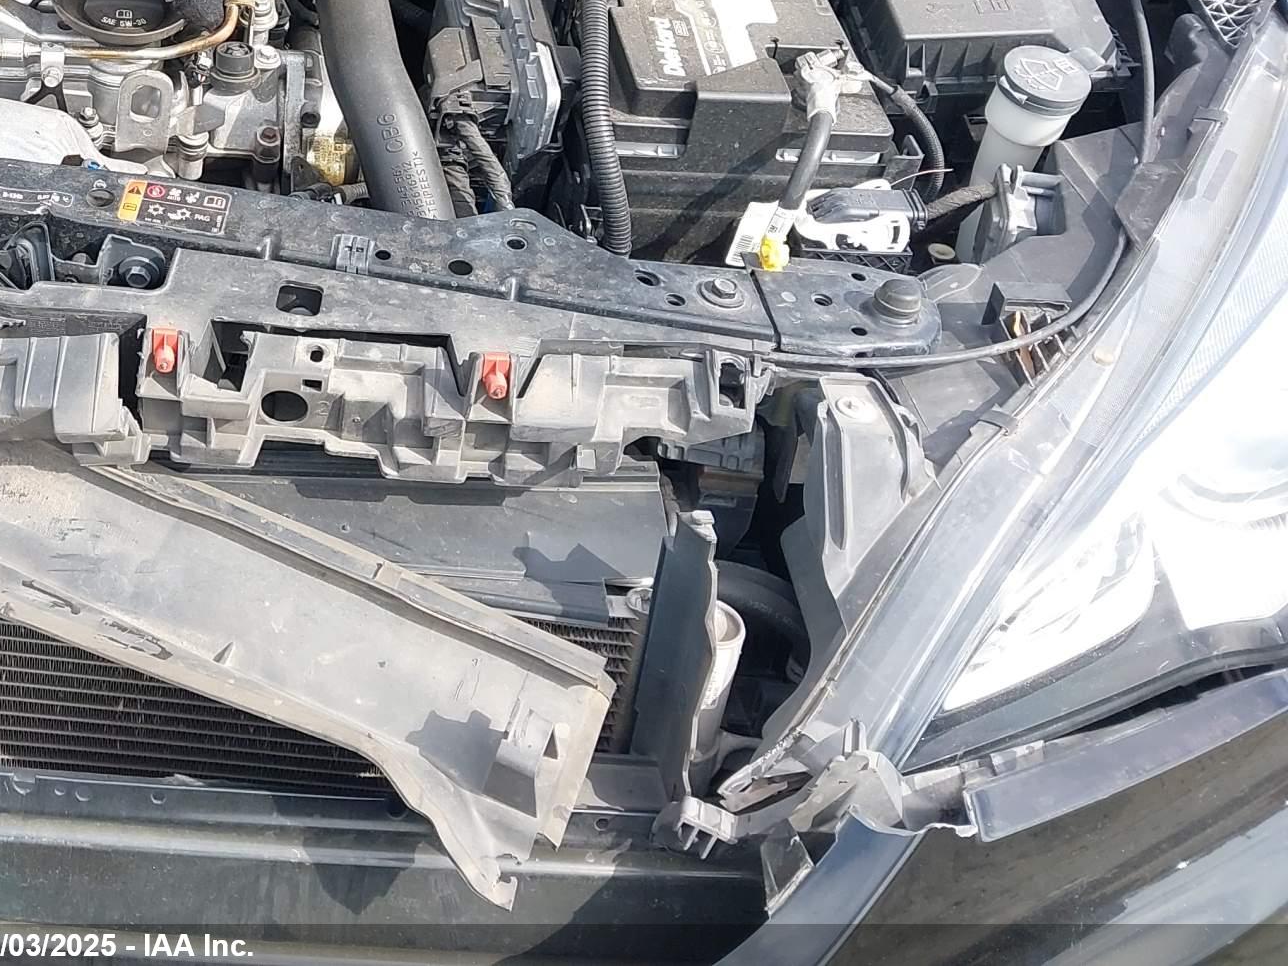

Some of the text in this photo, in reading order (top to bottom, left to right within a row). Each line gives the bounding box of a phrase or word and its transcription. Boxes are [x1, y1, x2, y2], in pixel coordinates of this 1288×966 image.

[100, 16, 147, 27] SAE 5W-30
[648, 16, 687, 77] DieHard
[376, 113, 405, 154] CB6
[193, 213, 211, 222] PAG
